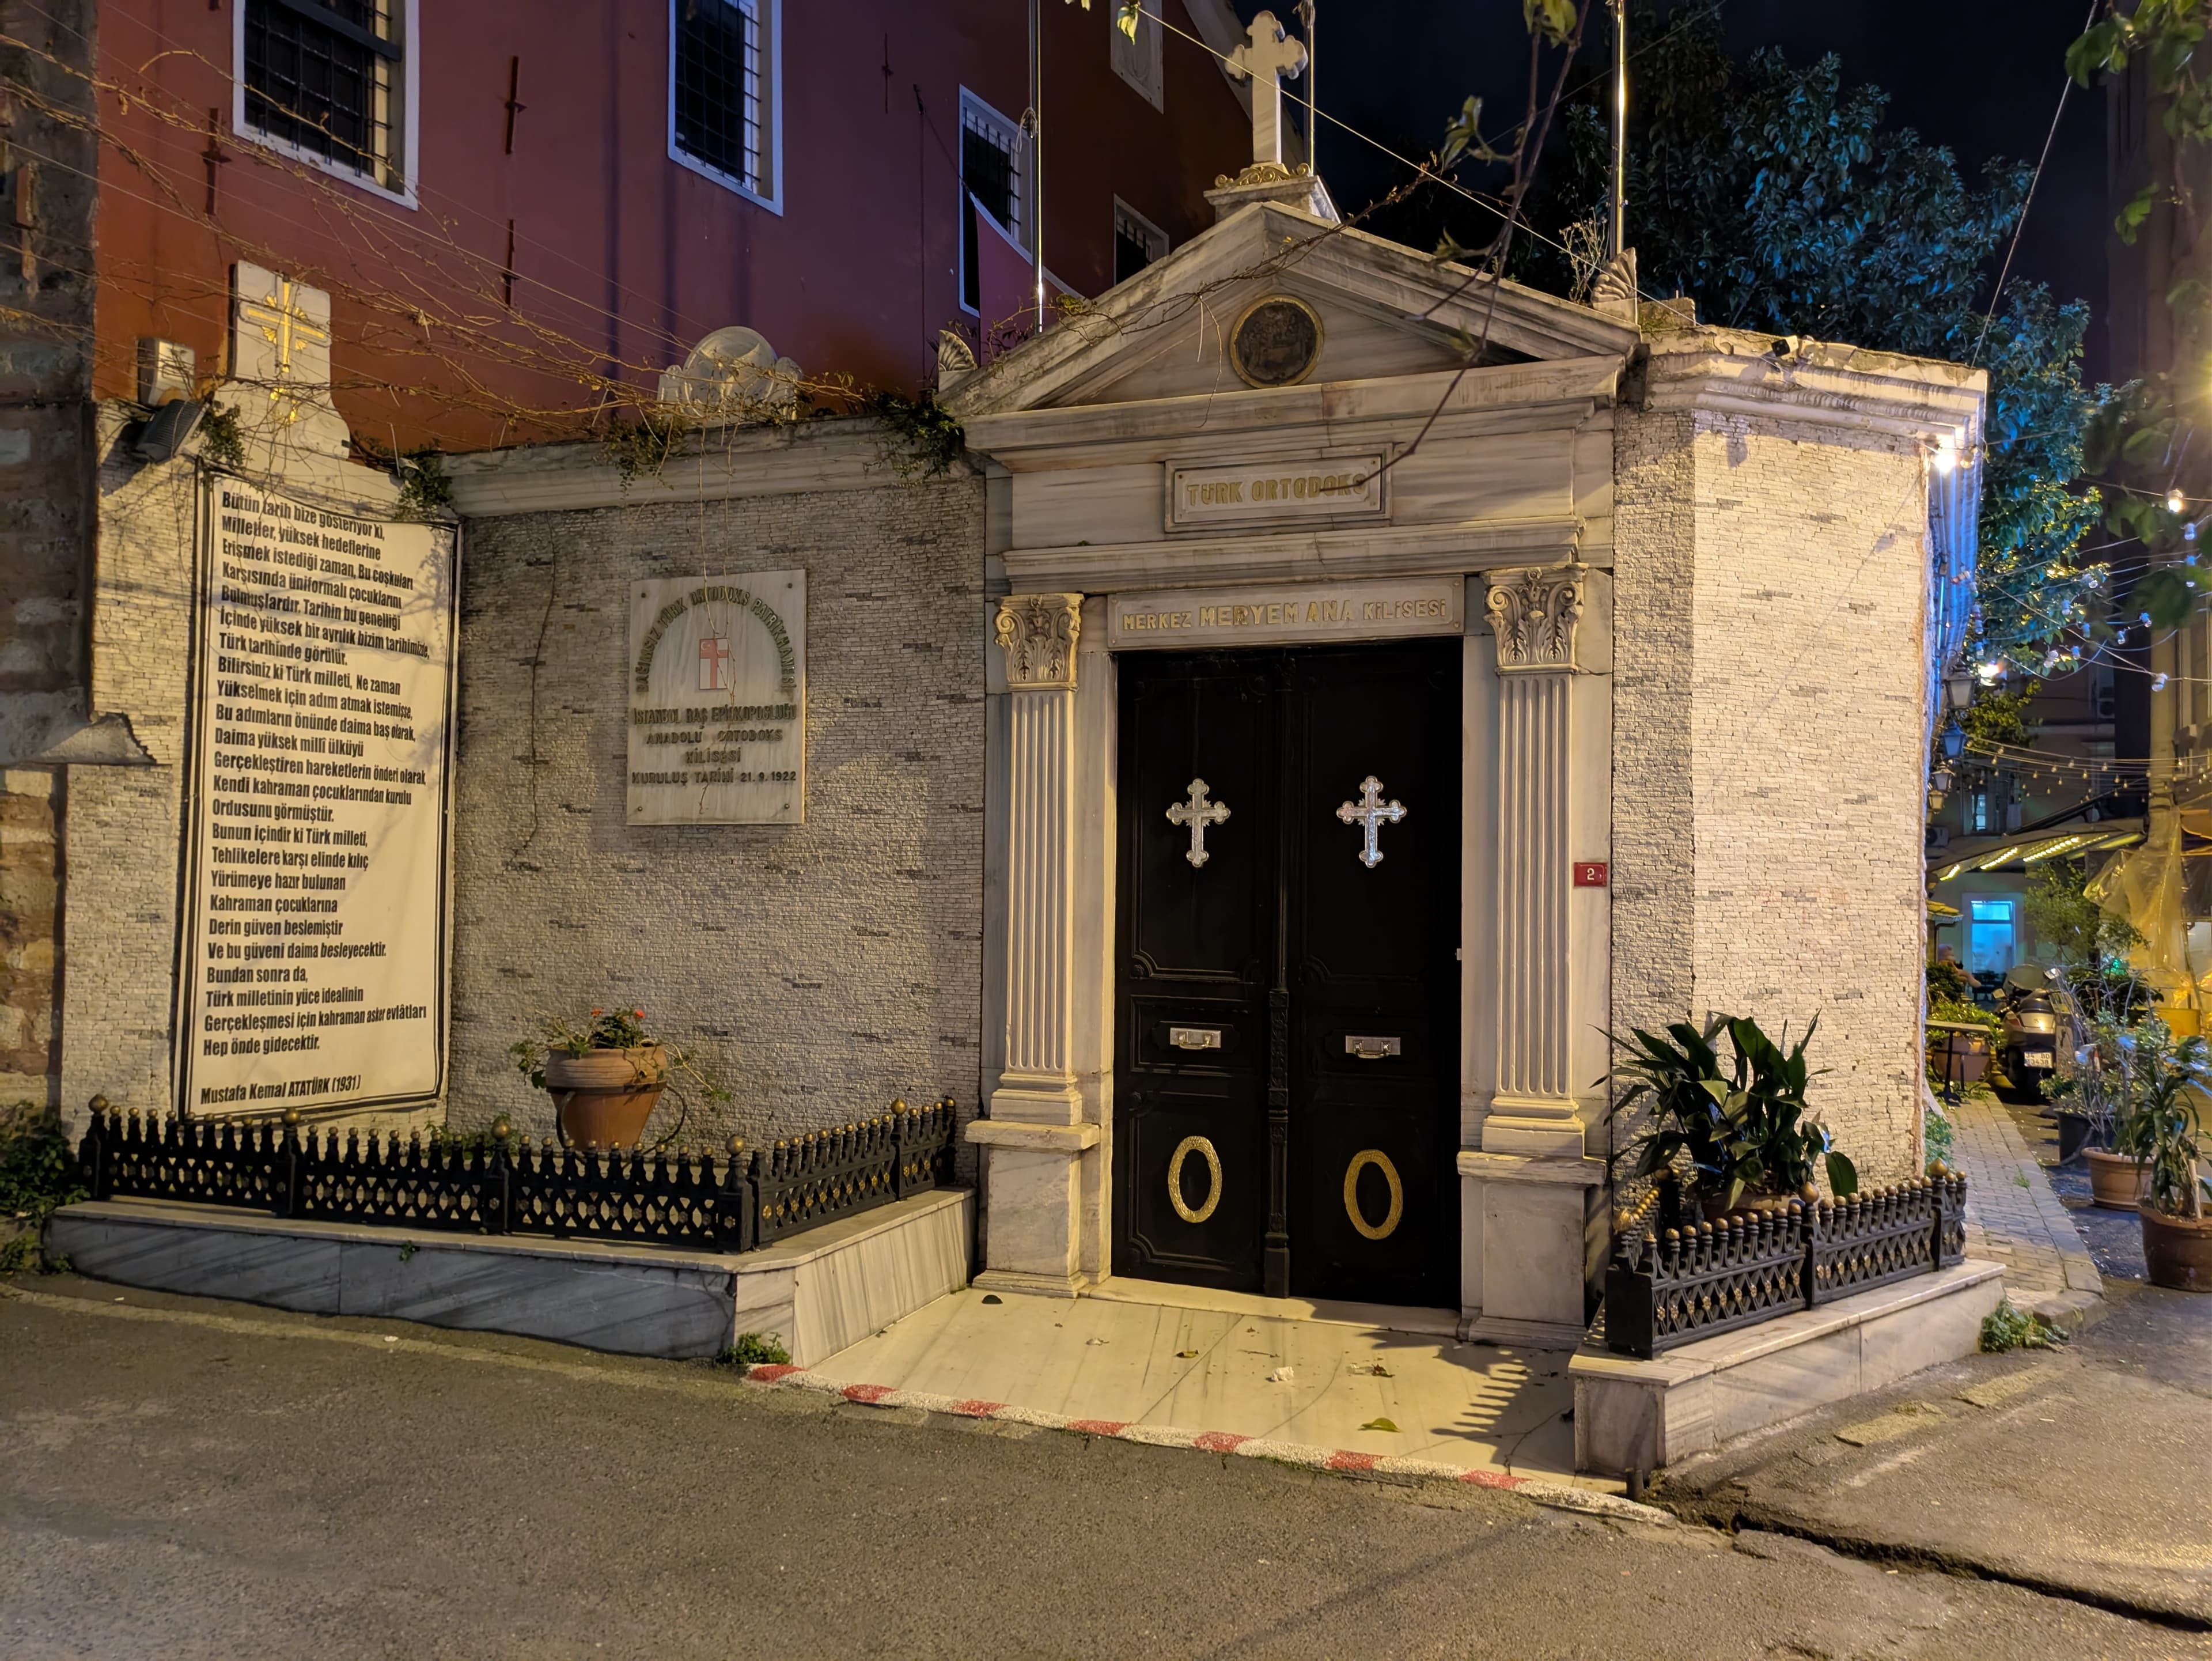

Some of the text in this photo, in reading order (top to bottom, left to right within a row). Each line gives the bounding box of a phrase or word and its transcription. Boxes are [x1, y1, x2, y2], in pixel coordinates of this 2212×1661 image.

[1252, 474, 1367, 501] ORTODOKS
[222, 491, 259, 513] Bütün
[263, 500, 291, 520] tarih
[294, 505, 317, 524] bize
[222, 515, 381, 561] Milletler, yüksek hedeflerine
[222, 538, 413, 591] Erişmek istediği zaman, Bu coşkuları
[222, 561, 402, 609] Karşısında üniformalı çocuklarını
[690, 585, 751, 606] ORTODOKS
[221, 585, 400, 631] Bulmuşlardır. Tarihin bu genelliği
[1123, 599, 1446, 630] MERKEZ MERYEM ANA KİLİSESİ
[220, 606, 257, 629] İçinde
[260, 615, 302, 637] yüksek
[305, 622, 320, 638] bir
[323, 627, 355, 645] ayrılık
[358, 631, 384, 649] bizim
[219, 632, 347, 665] Türk tarihinde görülür.
[218, 656, 400, 695] Bilirsiniz ki Türk milleti, Ne zaman
[217, 679, 412, 721] Yükselmek için adım atmak istemişse,
[216, 703, 233, 720] Bu
[236, 706, 291, 728] adımların
[295, 712, 337, 732] önünde
[340, 717, 372, 736] daima
[374, 721, 389, 740] baş
[215, 728, 255, 746] Daima
[258, 731, 297, 751] yüksek
[328, 737, 363, 758] ülküyü
[646, 728, 783, 744] ANADOLU ORTODOKS
[214, 751, 303, 775] Gerçekleştiren
[306, 759, 371, 780] hareketlerin
[373, 765, 398, 783] önderi
[685, 747, 741, 764] KİLİSESİ
[213, 775, 411, 805] Kendi kahraman çocuklarından kurulu
[632, 772, 688, 786] KURULUŞ
[695, 767, 734, 784] TARİHİ
[213, 799, 334, 824] Ordusunu görmüştür.
[213, 823, 368, 847] Bunun içindir ki Türk milleti,
[212, 846, 369, 871] Tehlikelere karşı elinde kılıç
[211, 870, 346, 890] Yürümeye hazır bulunan
[1587, 868, 1594, 880] 2
[210, 894, 338, 915] Kahraman çocuklarına
[209, 918, 343, 939] Derin güven beslemiştir
[208, 941, 387, 960] Ve bu güveni daima besleyecektir.
[207, 966, 308, 983] Bundan sonra da,
[206, 986, 363, 1007] Türk milletinin yüce idealinin
[204, 1012, 294, 1034] Gerçekleşmesi
[297, 1011, 316, 1031] için
[319, 1008, 365, 1027] kahraman
[387, 1004, 427, 1020] evlâtları
[203, 1034, 320, 1057] Hep önde gidecektir.
[200, 1084, 247, 1104] Mustafa
[249, 1081, 287, 1100] Kemal
[287, 1076, 330, 1098] ATATÜRK
